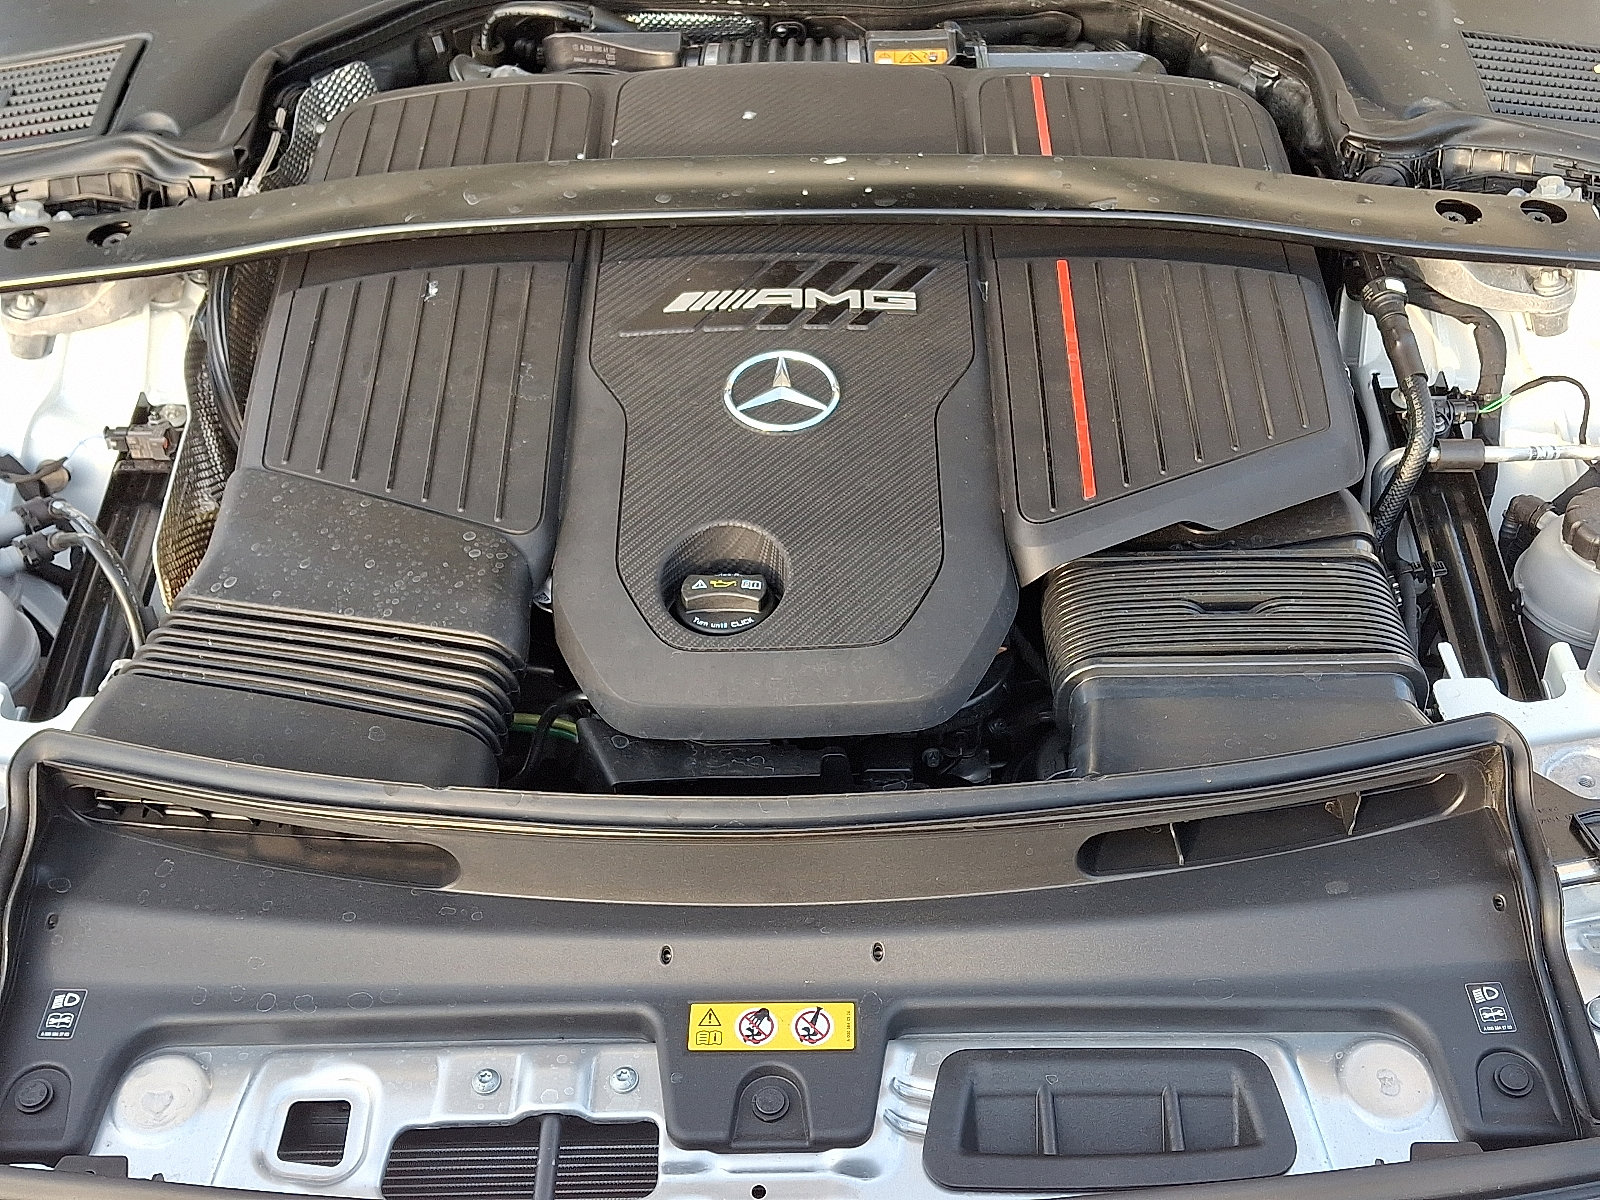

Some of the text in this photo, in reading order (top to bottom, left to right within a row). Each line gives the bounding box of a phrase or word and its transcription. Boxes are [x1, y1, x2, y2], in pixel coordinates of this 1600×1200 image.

[743, 288, 917, 311] AMG
[693, 616, 708, 627] Turn
[730, 616, 754, 628] CLICK
